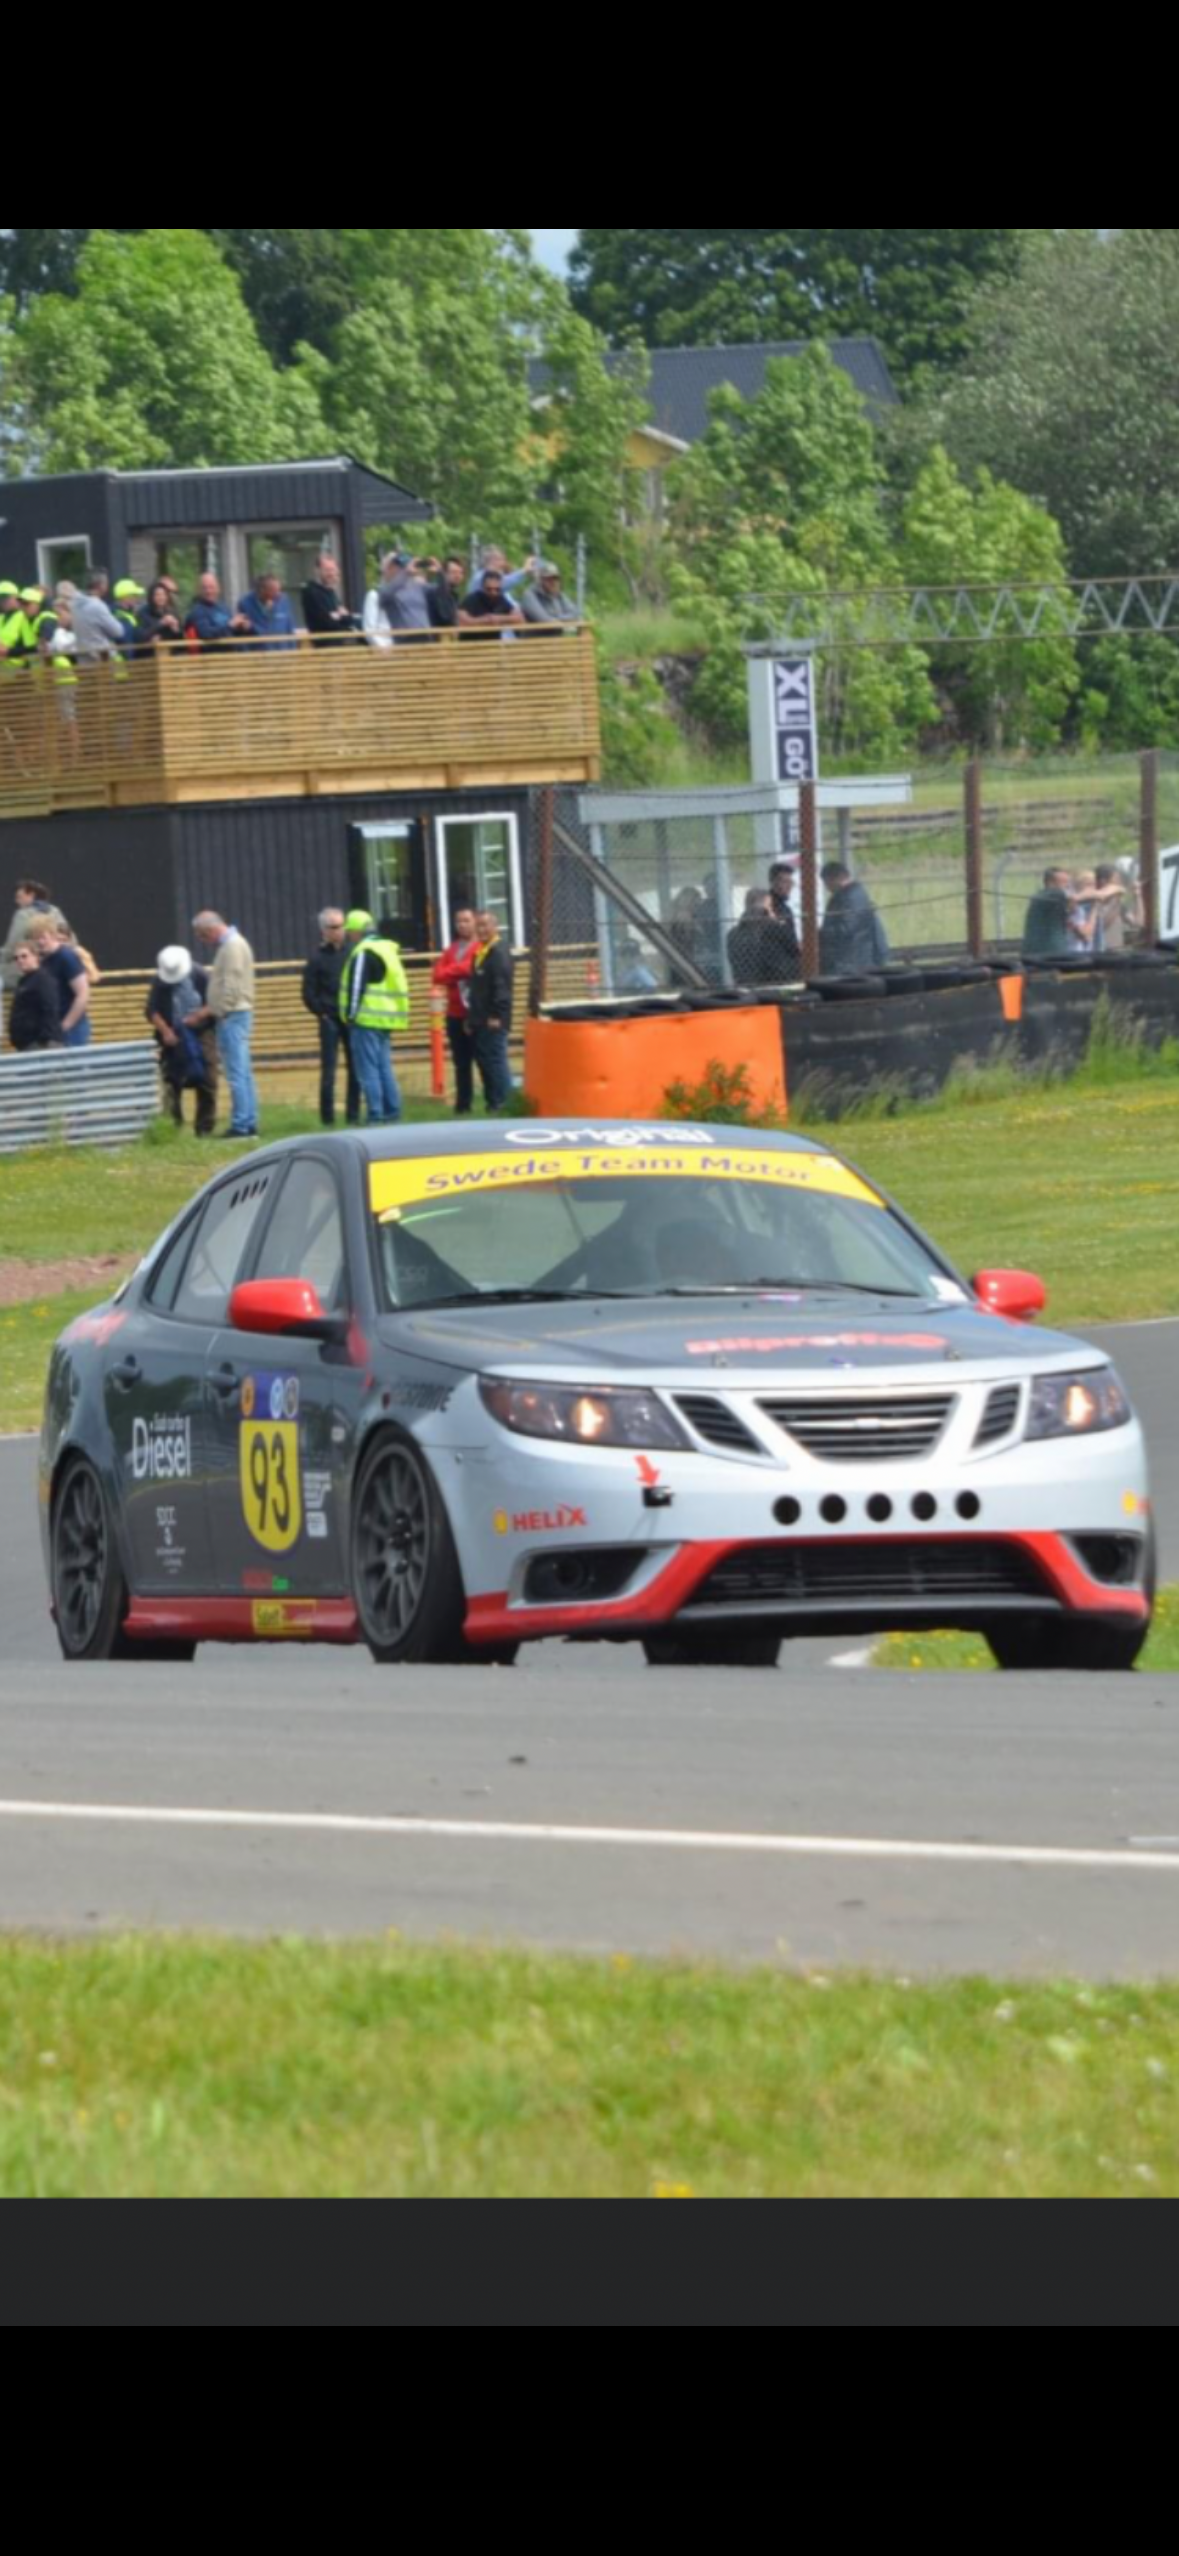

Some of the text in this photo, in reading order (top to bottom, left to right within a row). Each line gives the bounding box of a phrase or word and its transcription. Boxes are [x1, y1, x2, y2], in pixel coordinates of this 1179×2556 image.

[776, 663, 809, 724] XL
[504, 1126, 715, 1146] Original
[425, 1155, 813, 1191] Swede Team Motor
[132, 1415, 191, 1478] Diesel
[251, 1431, 290, 1533] 93
[512, 1503, 587, 1532] HELIX
